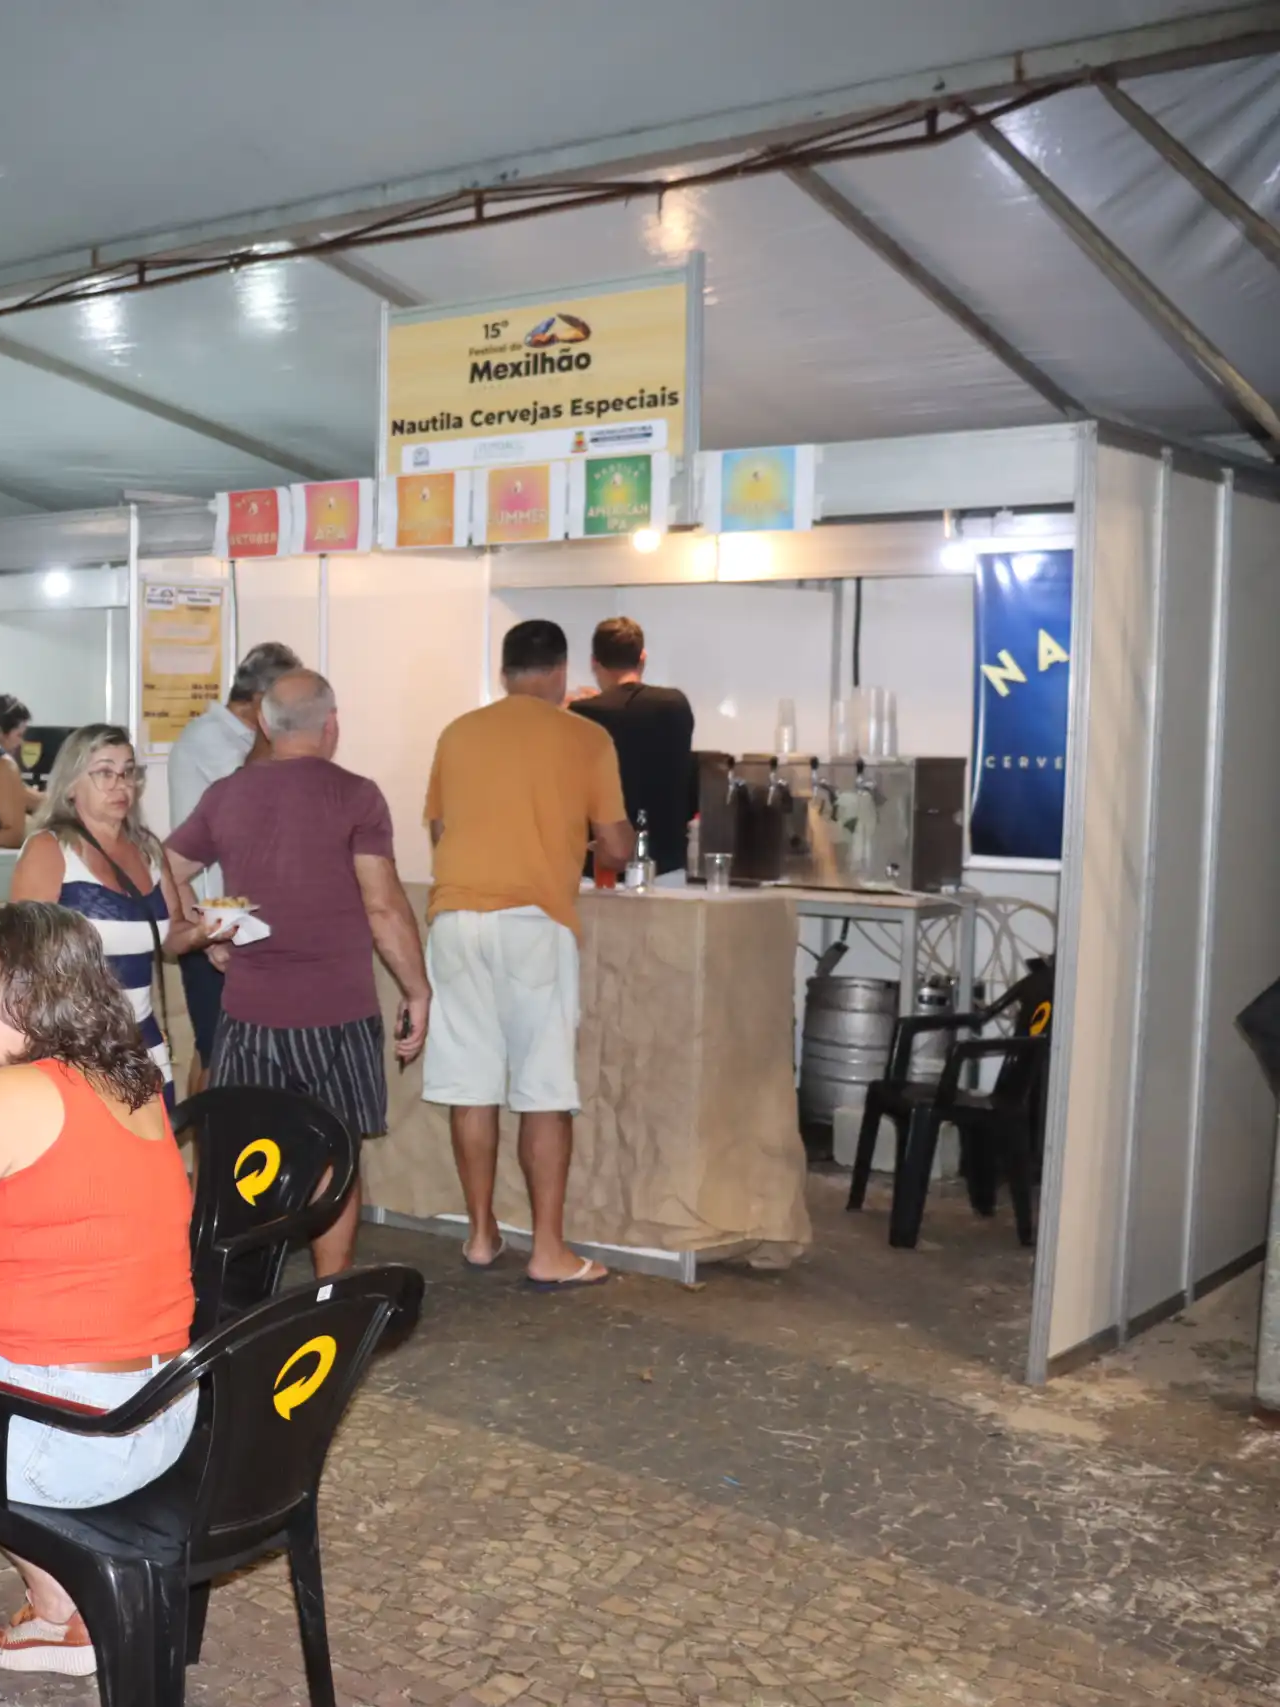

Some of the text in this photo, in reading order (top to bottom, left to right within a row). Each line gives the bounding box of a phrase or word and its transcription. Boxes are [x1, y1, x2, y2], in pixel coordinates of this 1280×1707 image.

[469, 347, 591, 383] Mexilhão
[391, 386, 679, 436] Nautila Cervejas Especiais
